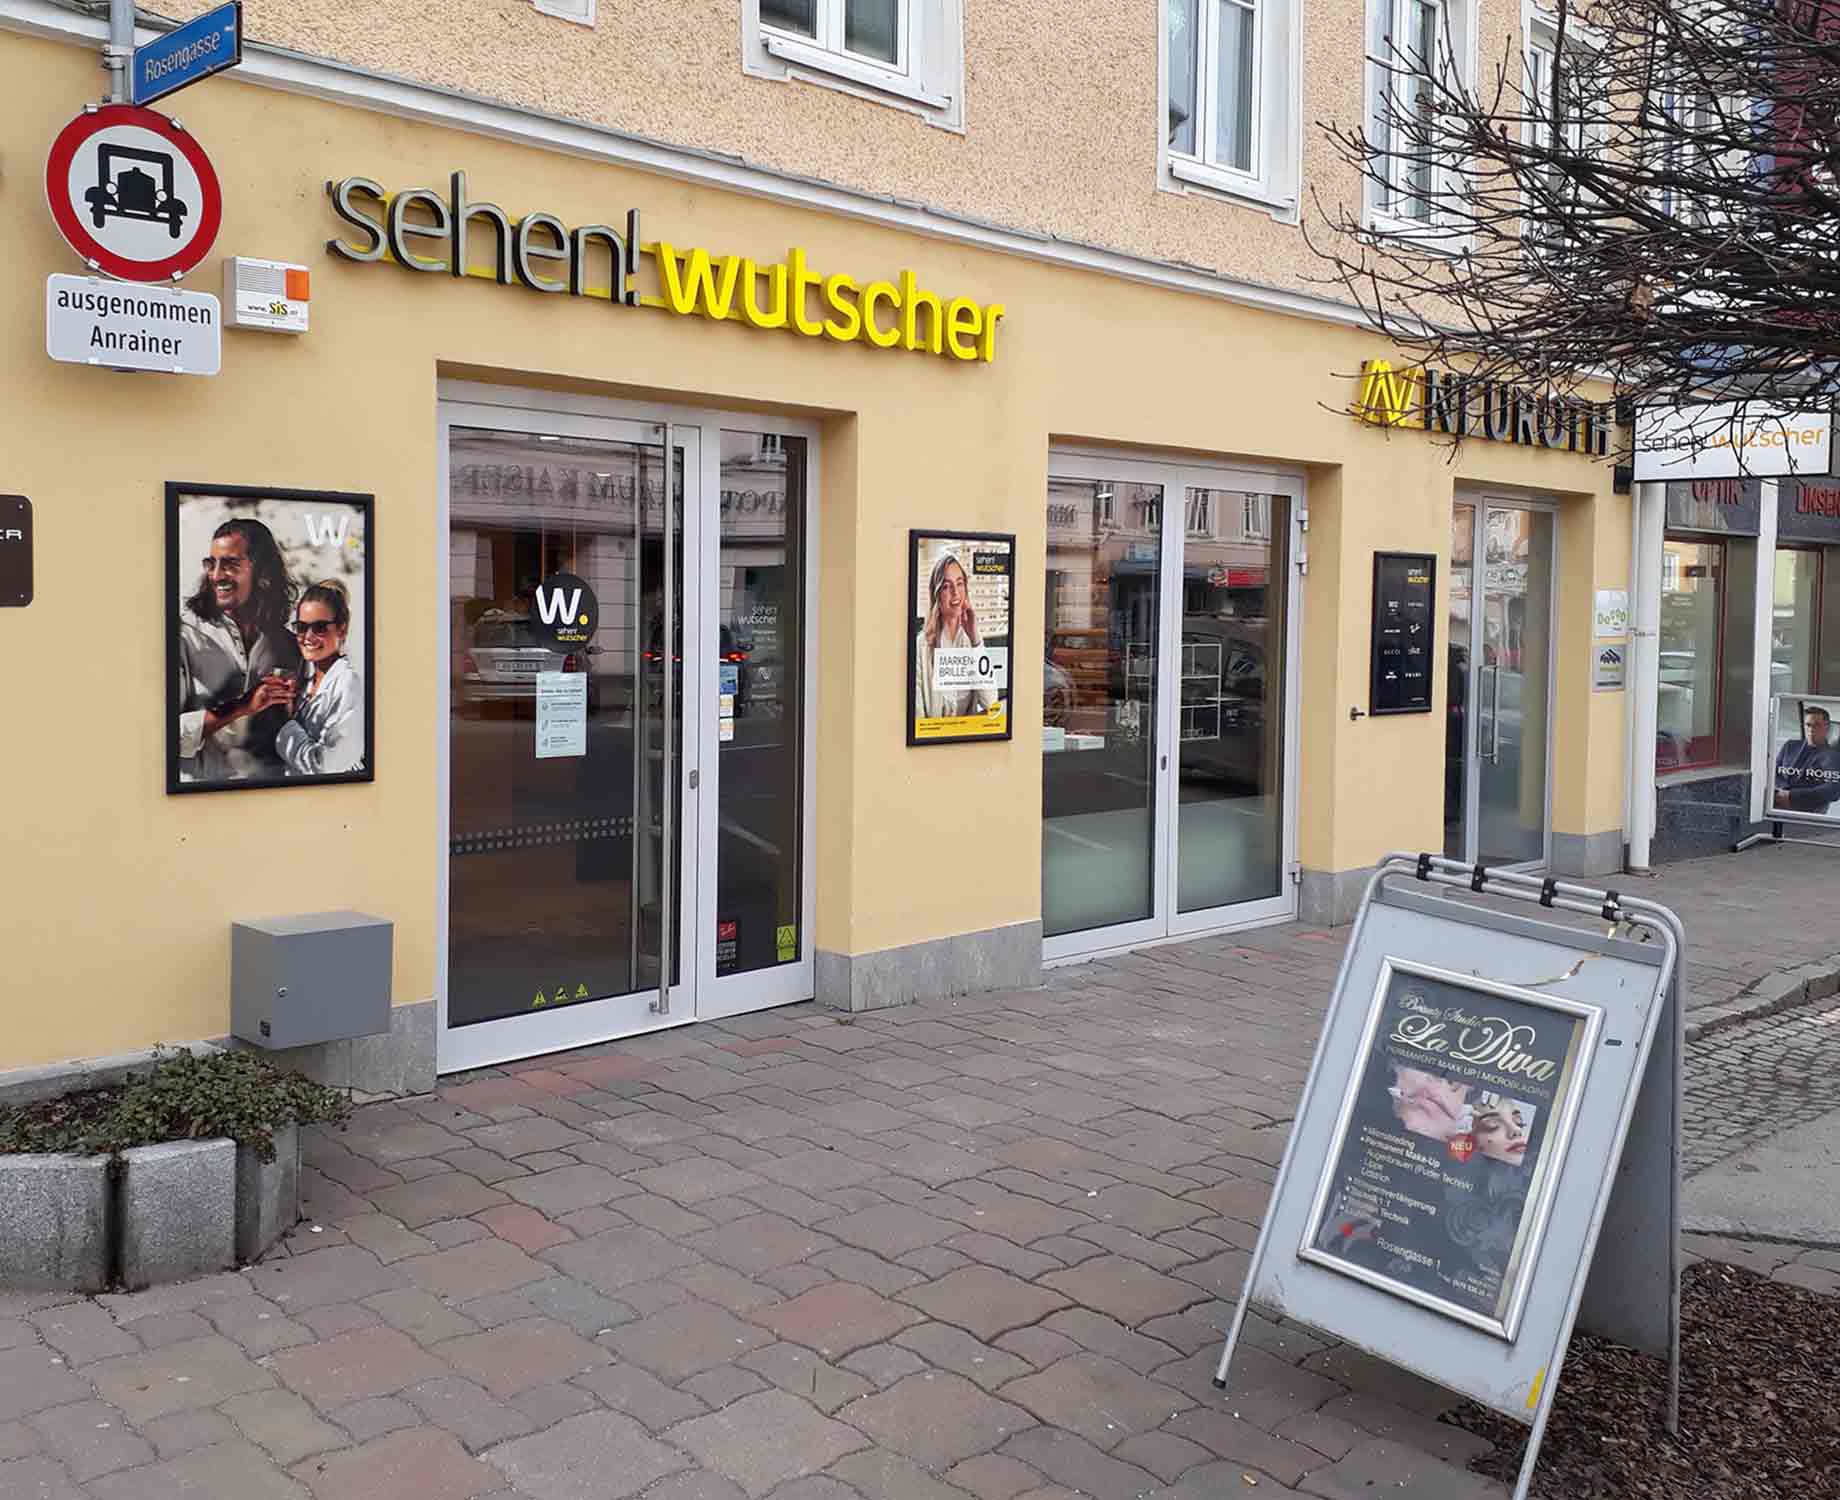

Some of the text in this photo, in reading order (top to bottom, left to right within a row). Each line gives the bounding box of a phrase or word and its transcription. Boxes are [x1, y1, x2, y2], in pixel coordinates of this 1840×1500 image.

[144, 31, 221, 82] Rosengasse
[324, 169, 1006, 363] sehen! wutscher
[57, 289, 212, 326] ausgenommen
[90, 325, 182, 355] Anrainer
[1777, 766, 1803, 776] ROY
[1390, 1015, 1556, 1082] La Diva
[1450, 1143, 1473, 1151] NEU
[1376, 1236, 1434, 1267] Rosengasse
